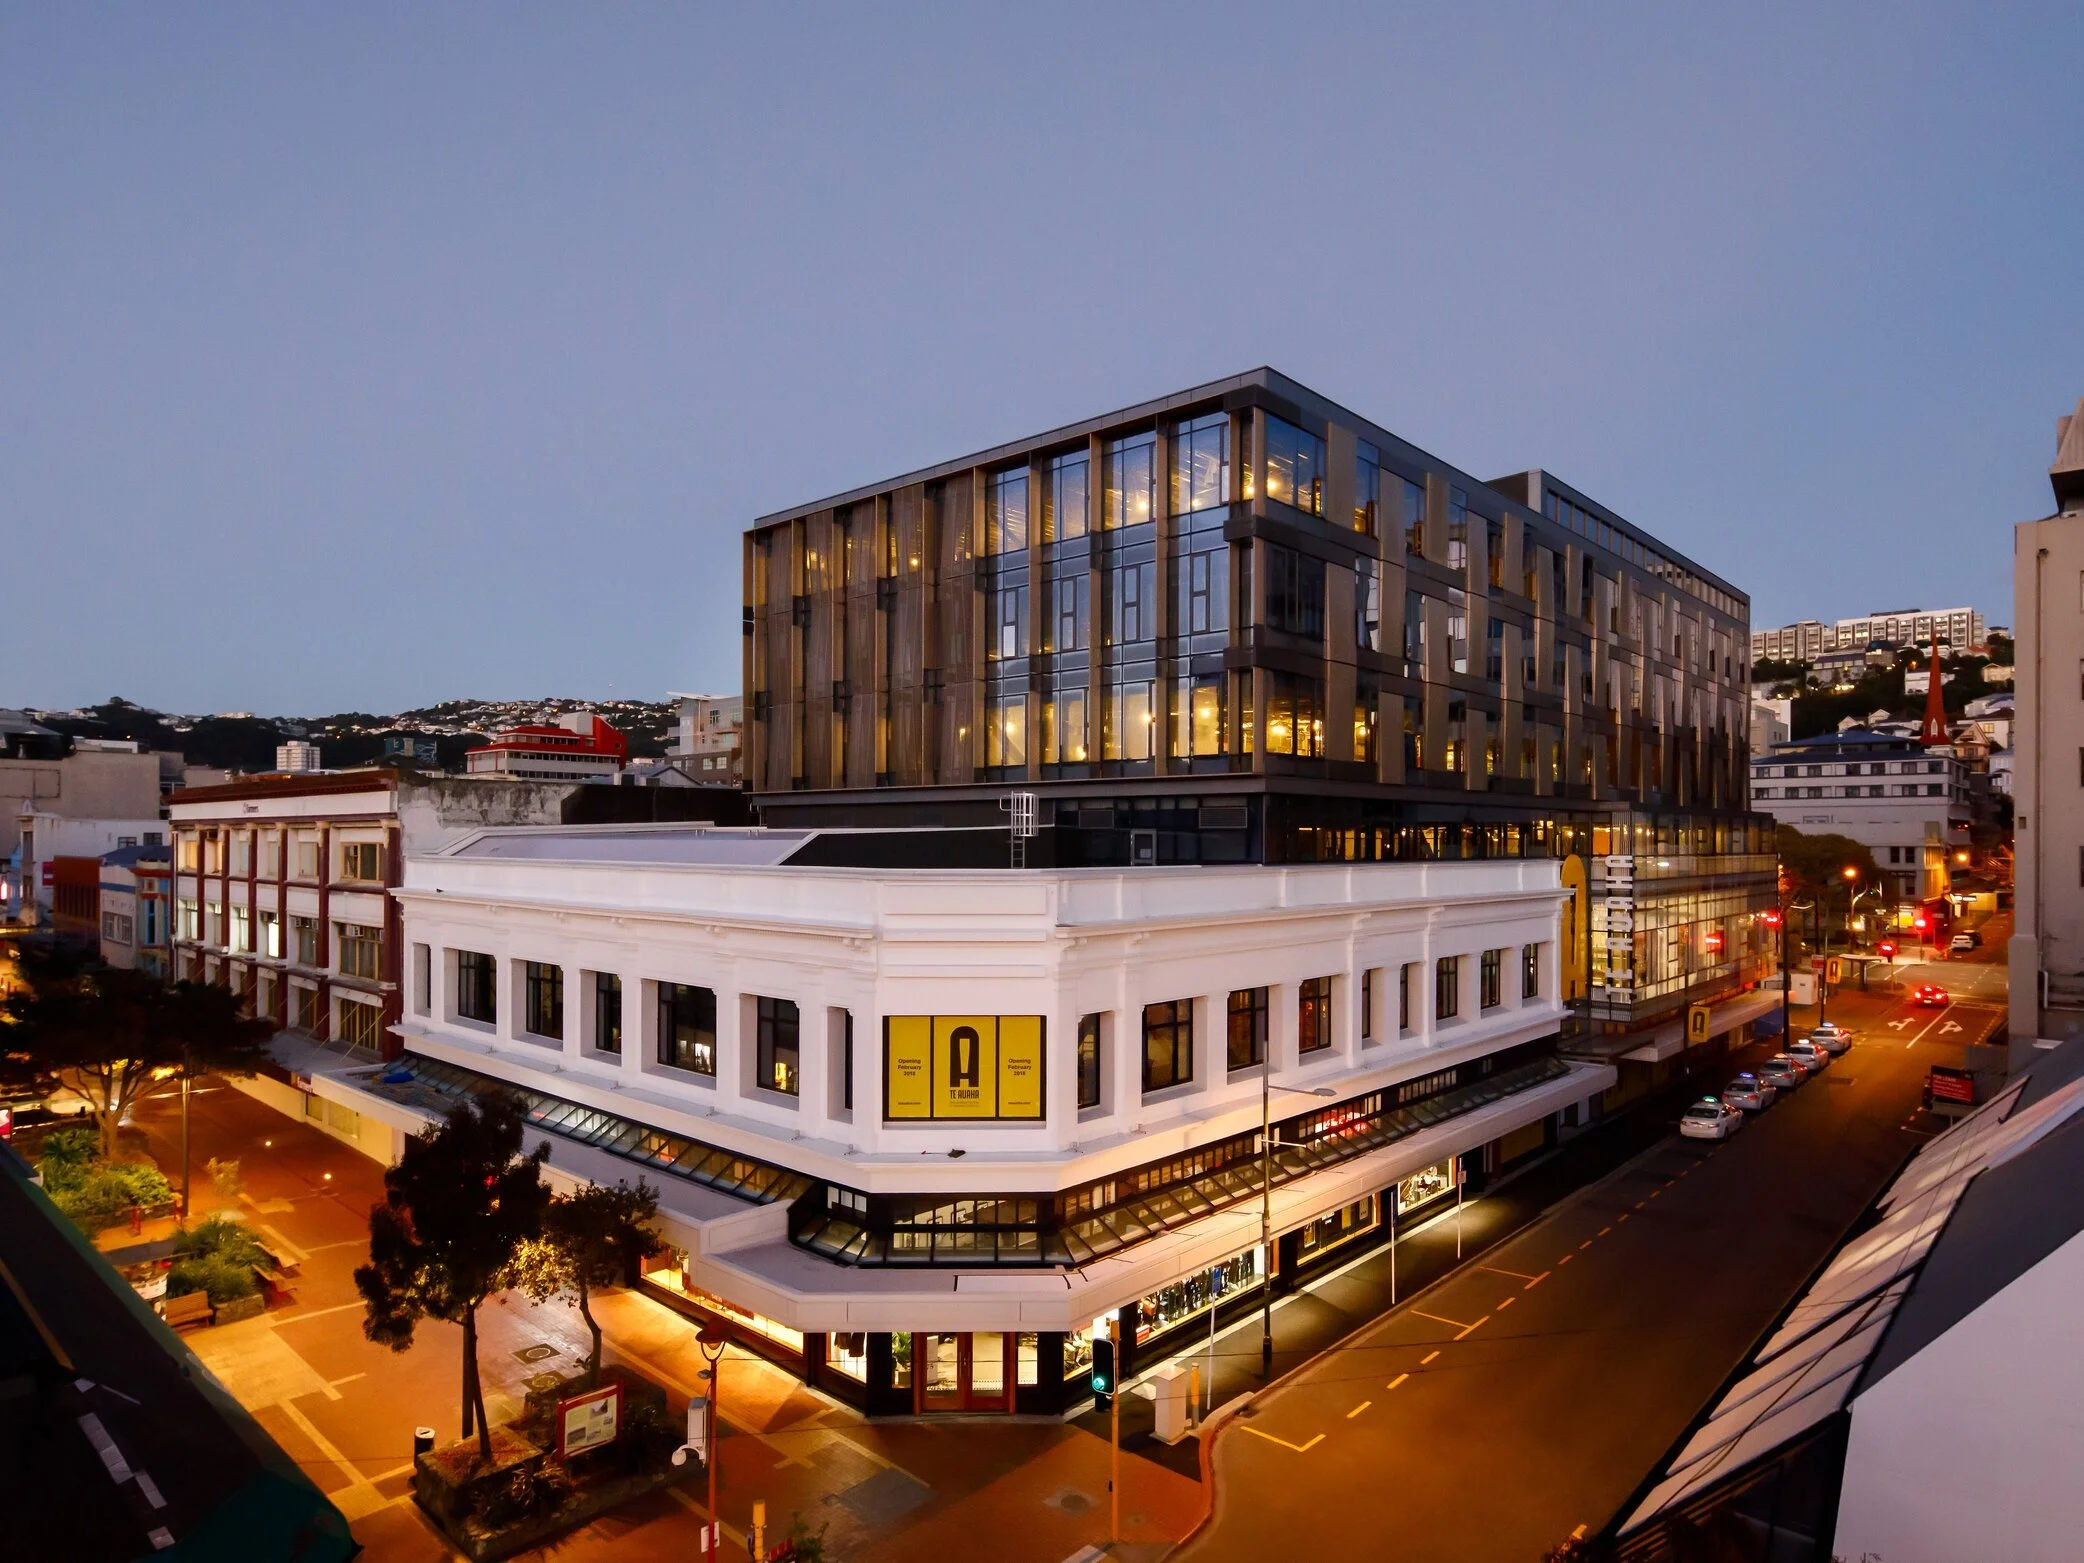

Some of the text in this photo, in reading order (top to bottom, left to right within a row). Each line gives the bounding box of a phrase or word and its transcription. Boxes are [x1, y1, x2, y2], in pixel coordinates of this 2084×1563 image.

[1605, 855, 1633, 995] TE AUAHA
[950, 1090, 980, 1099] TE AUAHA
